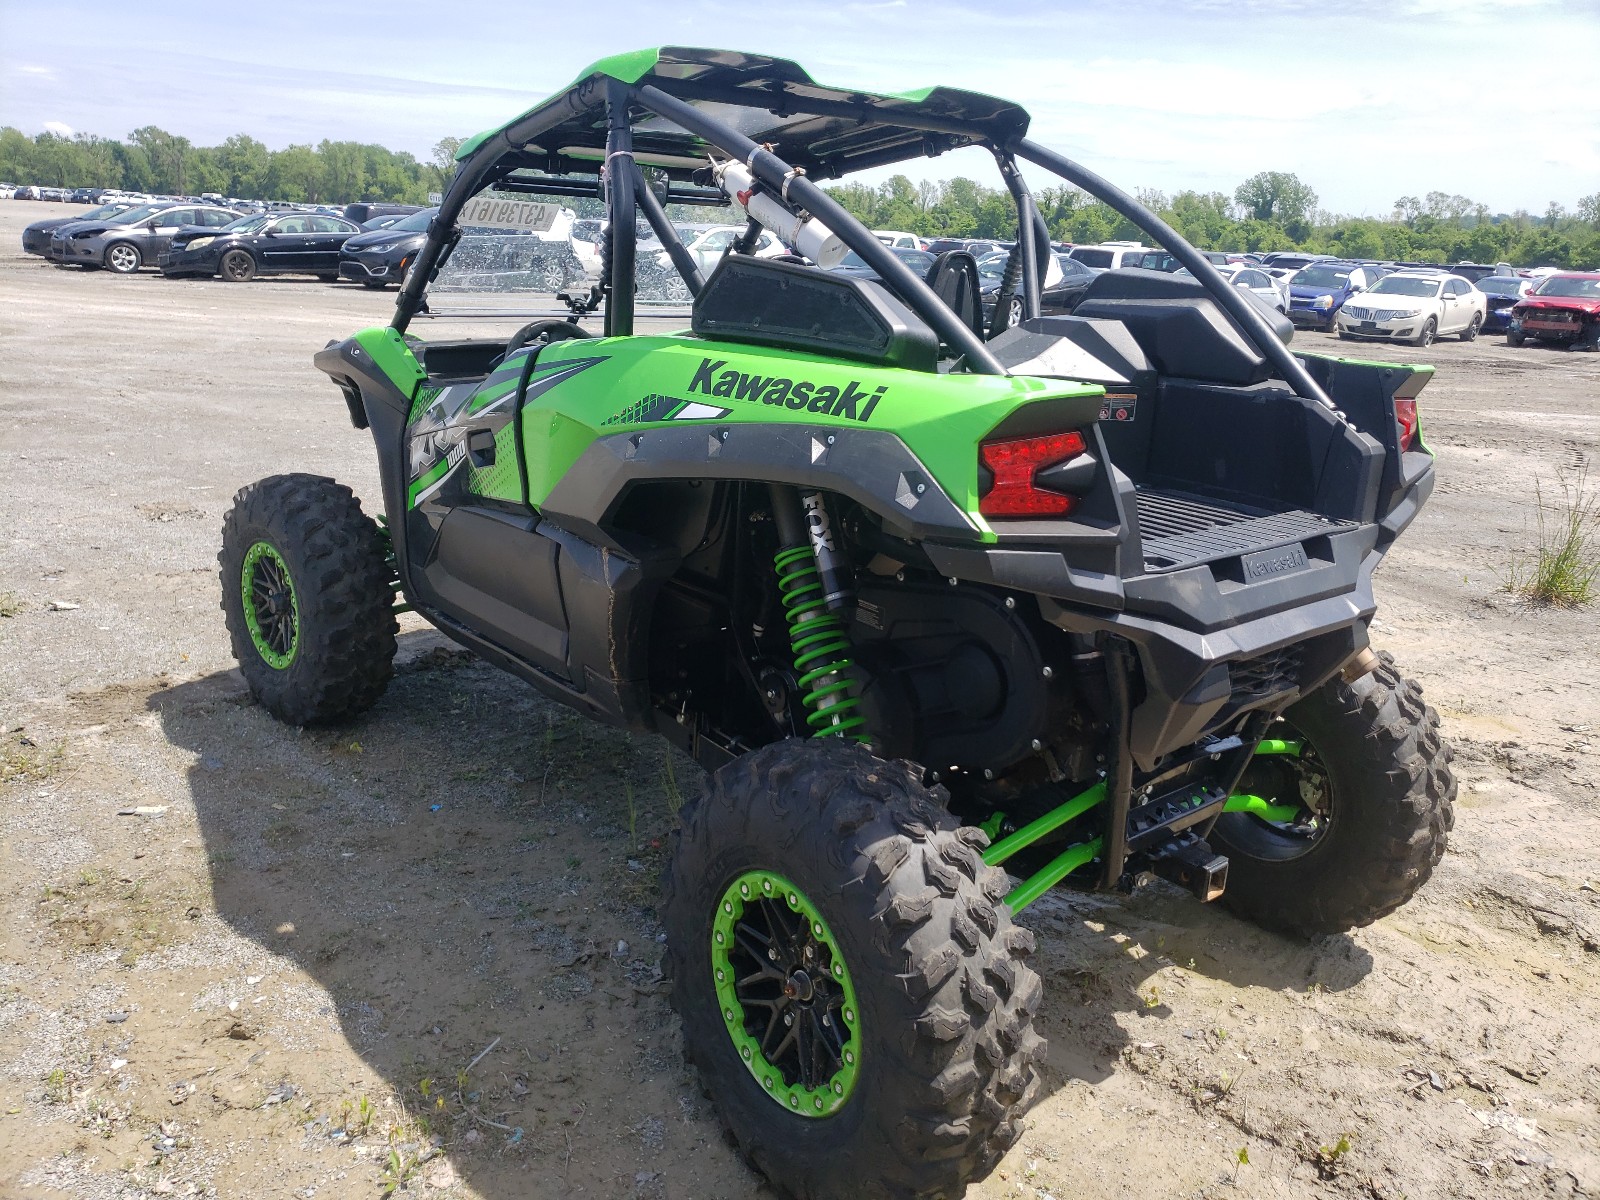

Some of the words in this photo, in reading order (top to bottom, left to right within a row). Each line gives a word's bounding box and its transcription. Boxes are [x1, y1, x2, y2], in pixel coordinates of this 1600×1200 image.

[687, 357, 889, 422] Kawasaki
[446, 439, 466, 470] 1000
[802, 492, 836, 557] FOX
[1245, 549, 1305, 579] Kawasaki
